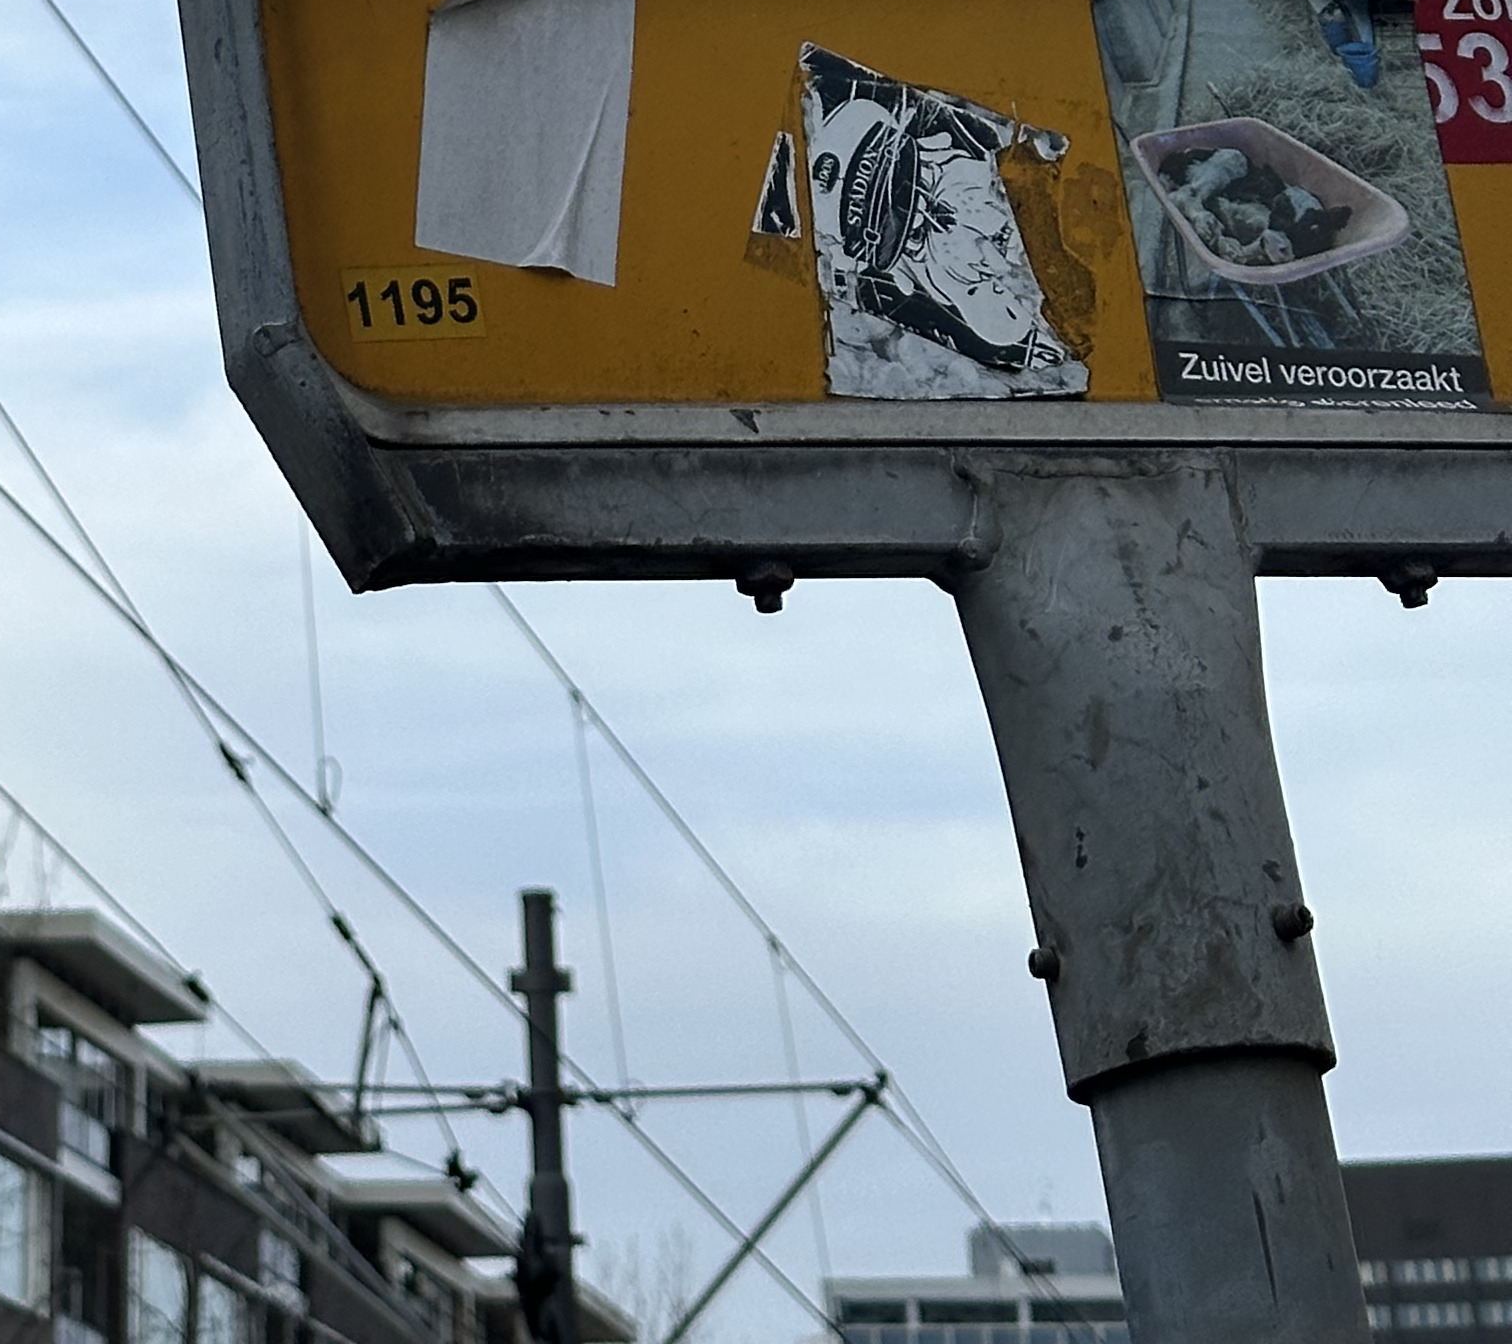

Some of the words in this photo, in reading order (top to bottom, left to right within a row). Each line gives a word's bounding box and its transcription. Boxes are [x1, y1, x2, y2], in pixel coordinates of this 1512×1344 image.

[847, 146, 877, 225] STADION
[347, 277, 478, 328] 1195
[1178, 352, 1271, 384] Zuivel
[1280, 362, 1464, 393] veroorzaakt
